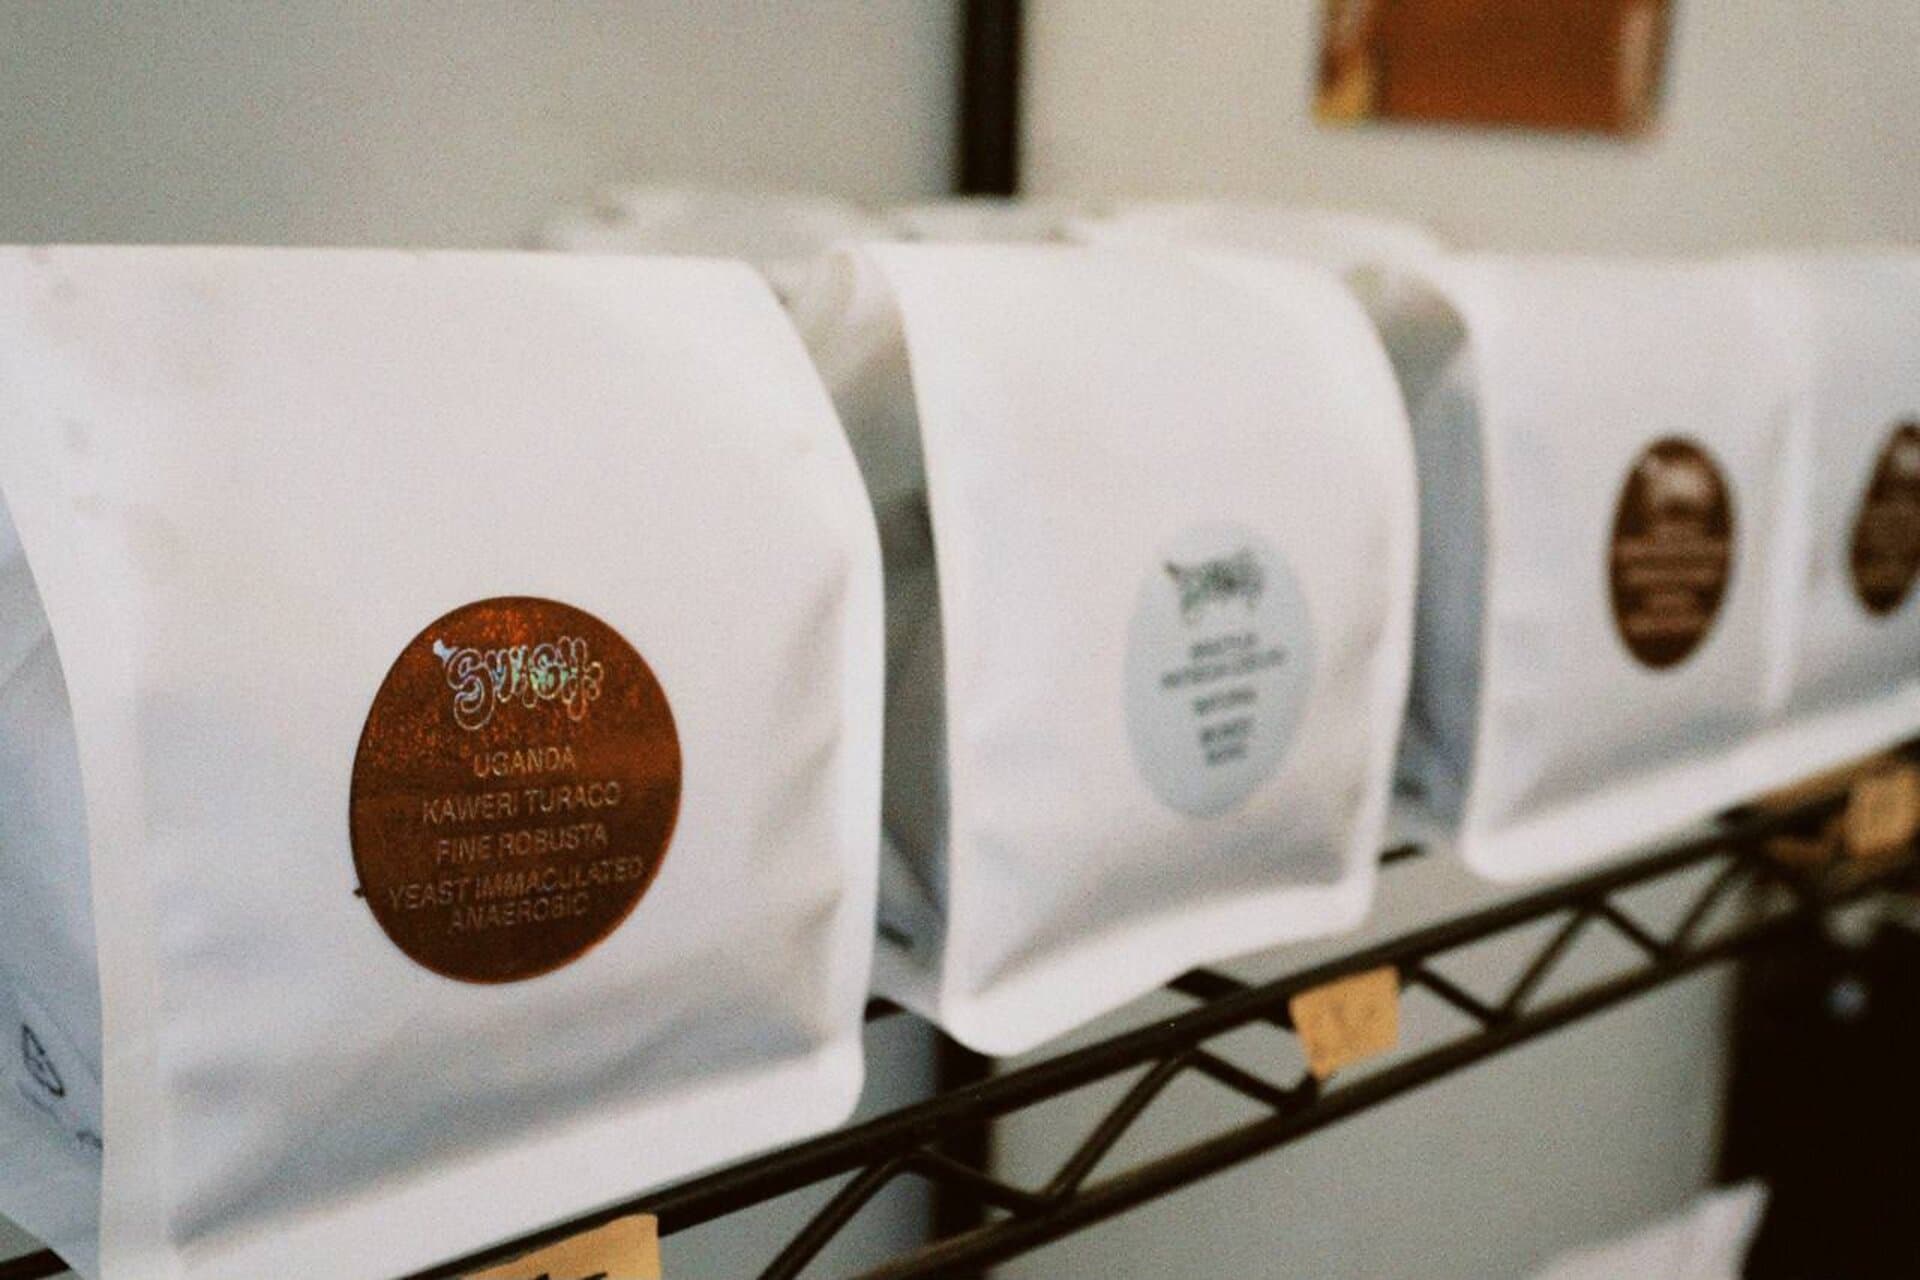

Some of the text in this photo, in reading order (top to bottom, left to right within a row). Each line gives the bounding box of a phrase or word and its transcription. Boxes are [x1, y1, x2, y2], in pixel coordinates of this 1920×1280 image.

[473, 745, 577, 779] UGANDA
[422, 780, 622, 825] KAWERI TURACO
[435, 822, 610, 865] FINE ROBUSTA
[388, 877, 469, 911] YEAST
[447, 892, 591, 934] ANAEROBIC
